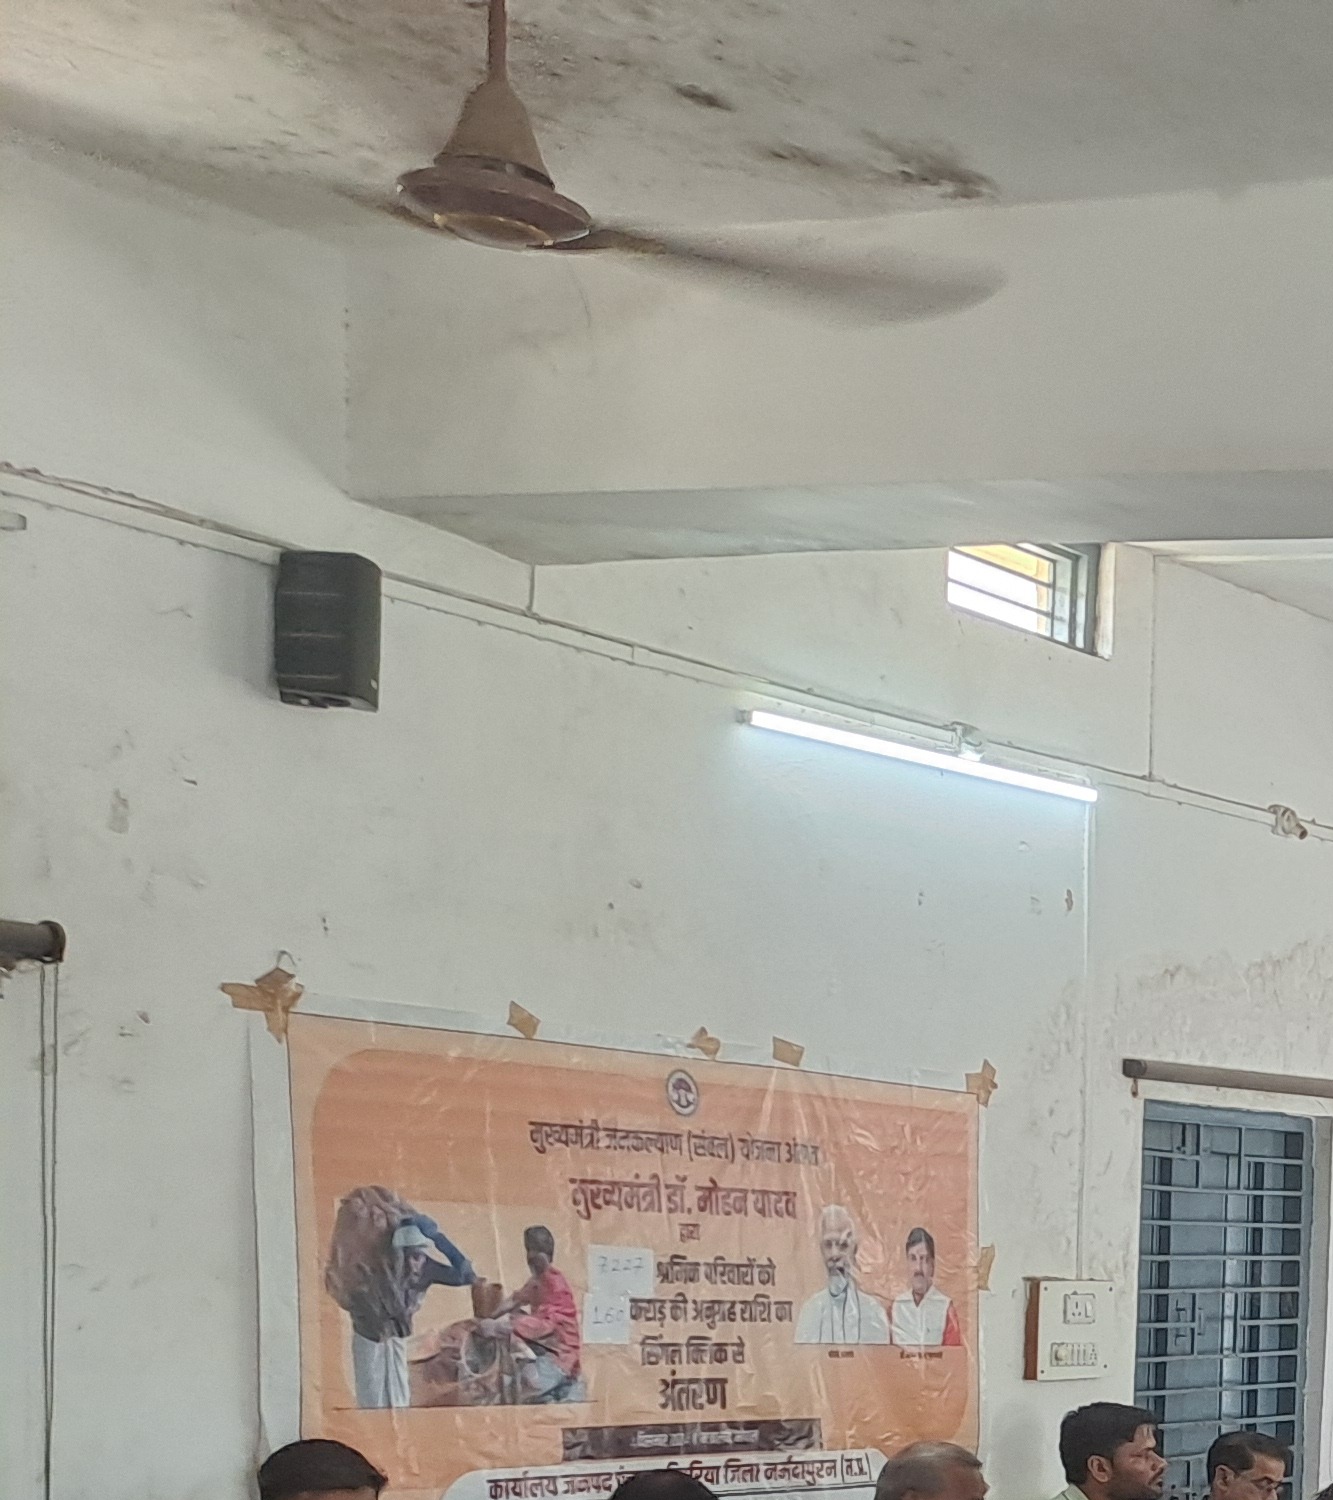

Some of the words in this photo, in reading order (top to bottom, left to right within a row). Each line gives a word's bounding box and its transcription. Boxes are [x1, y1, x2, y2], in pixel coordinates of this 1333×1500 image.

[695, 1177, 749, 1217] मोहन
[751, 1188, 797, 1219] यादव
[658, 1369, 729, 1411] अंतरण
